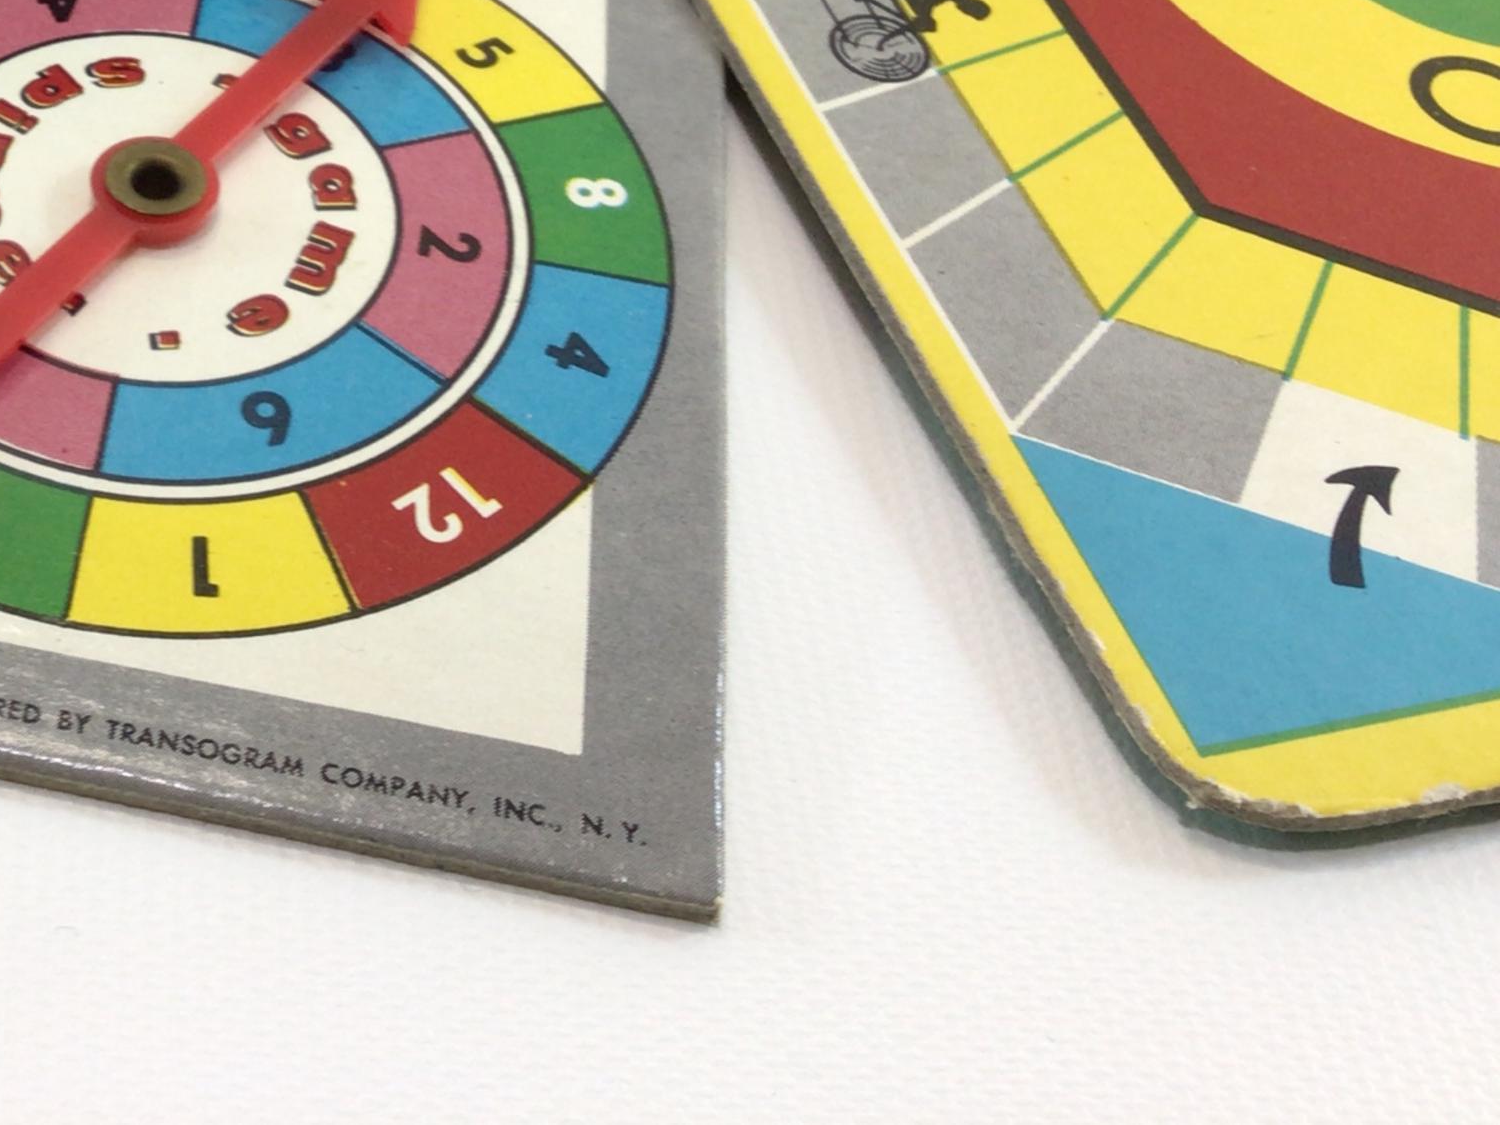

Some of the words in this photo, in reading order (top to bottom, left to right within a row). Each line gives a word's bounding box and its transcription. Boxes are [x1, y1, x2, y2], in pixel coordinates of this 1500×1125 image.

[456, 36, 515, 69] 5
[564, 177, 629, 208] 8
[417, 225, 483, 263] 2
[545, 332, 611, 378] 4
[391, 467, 504, 544] 12
[192, 536, 220, 598] 1
[56, 709, 92, 734] BY
[105, 719, 305, 777] TRANSOGRAM
[320, 762, 477, 815] COMPANY,
